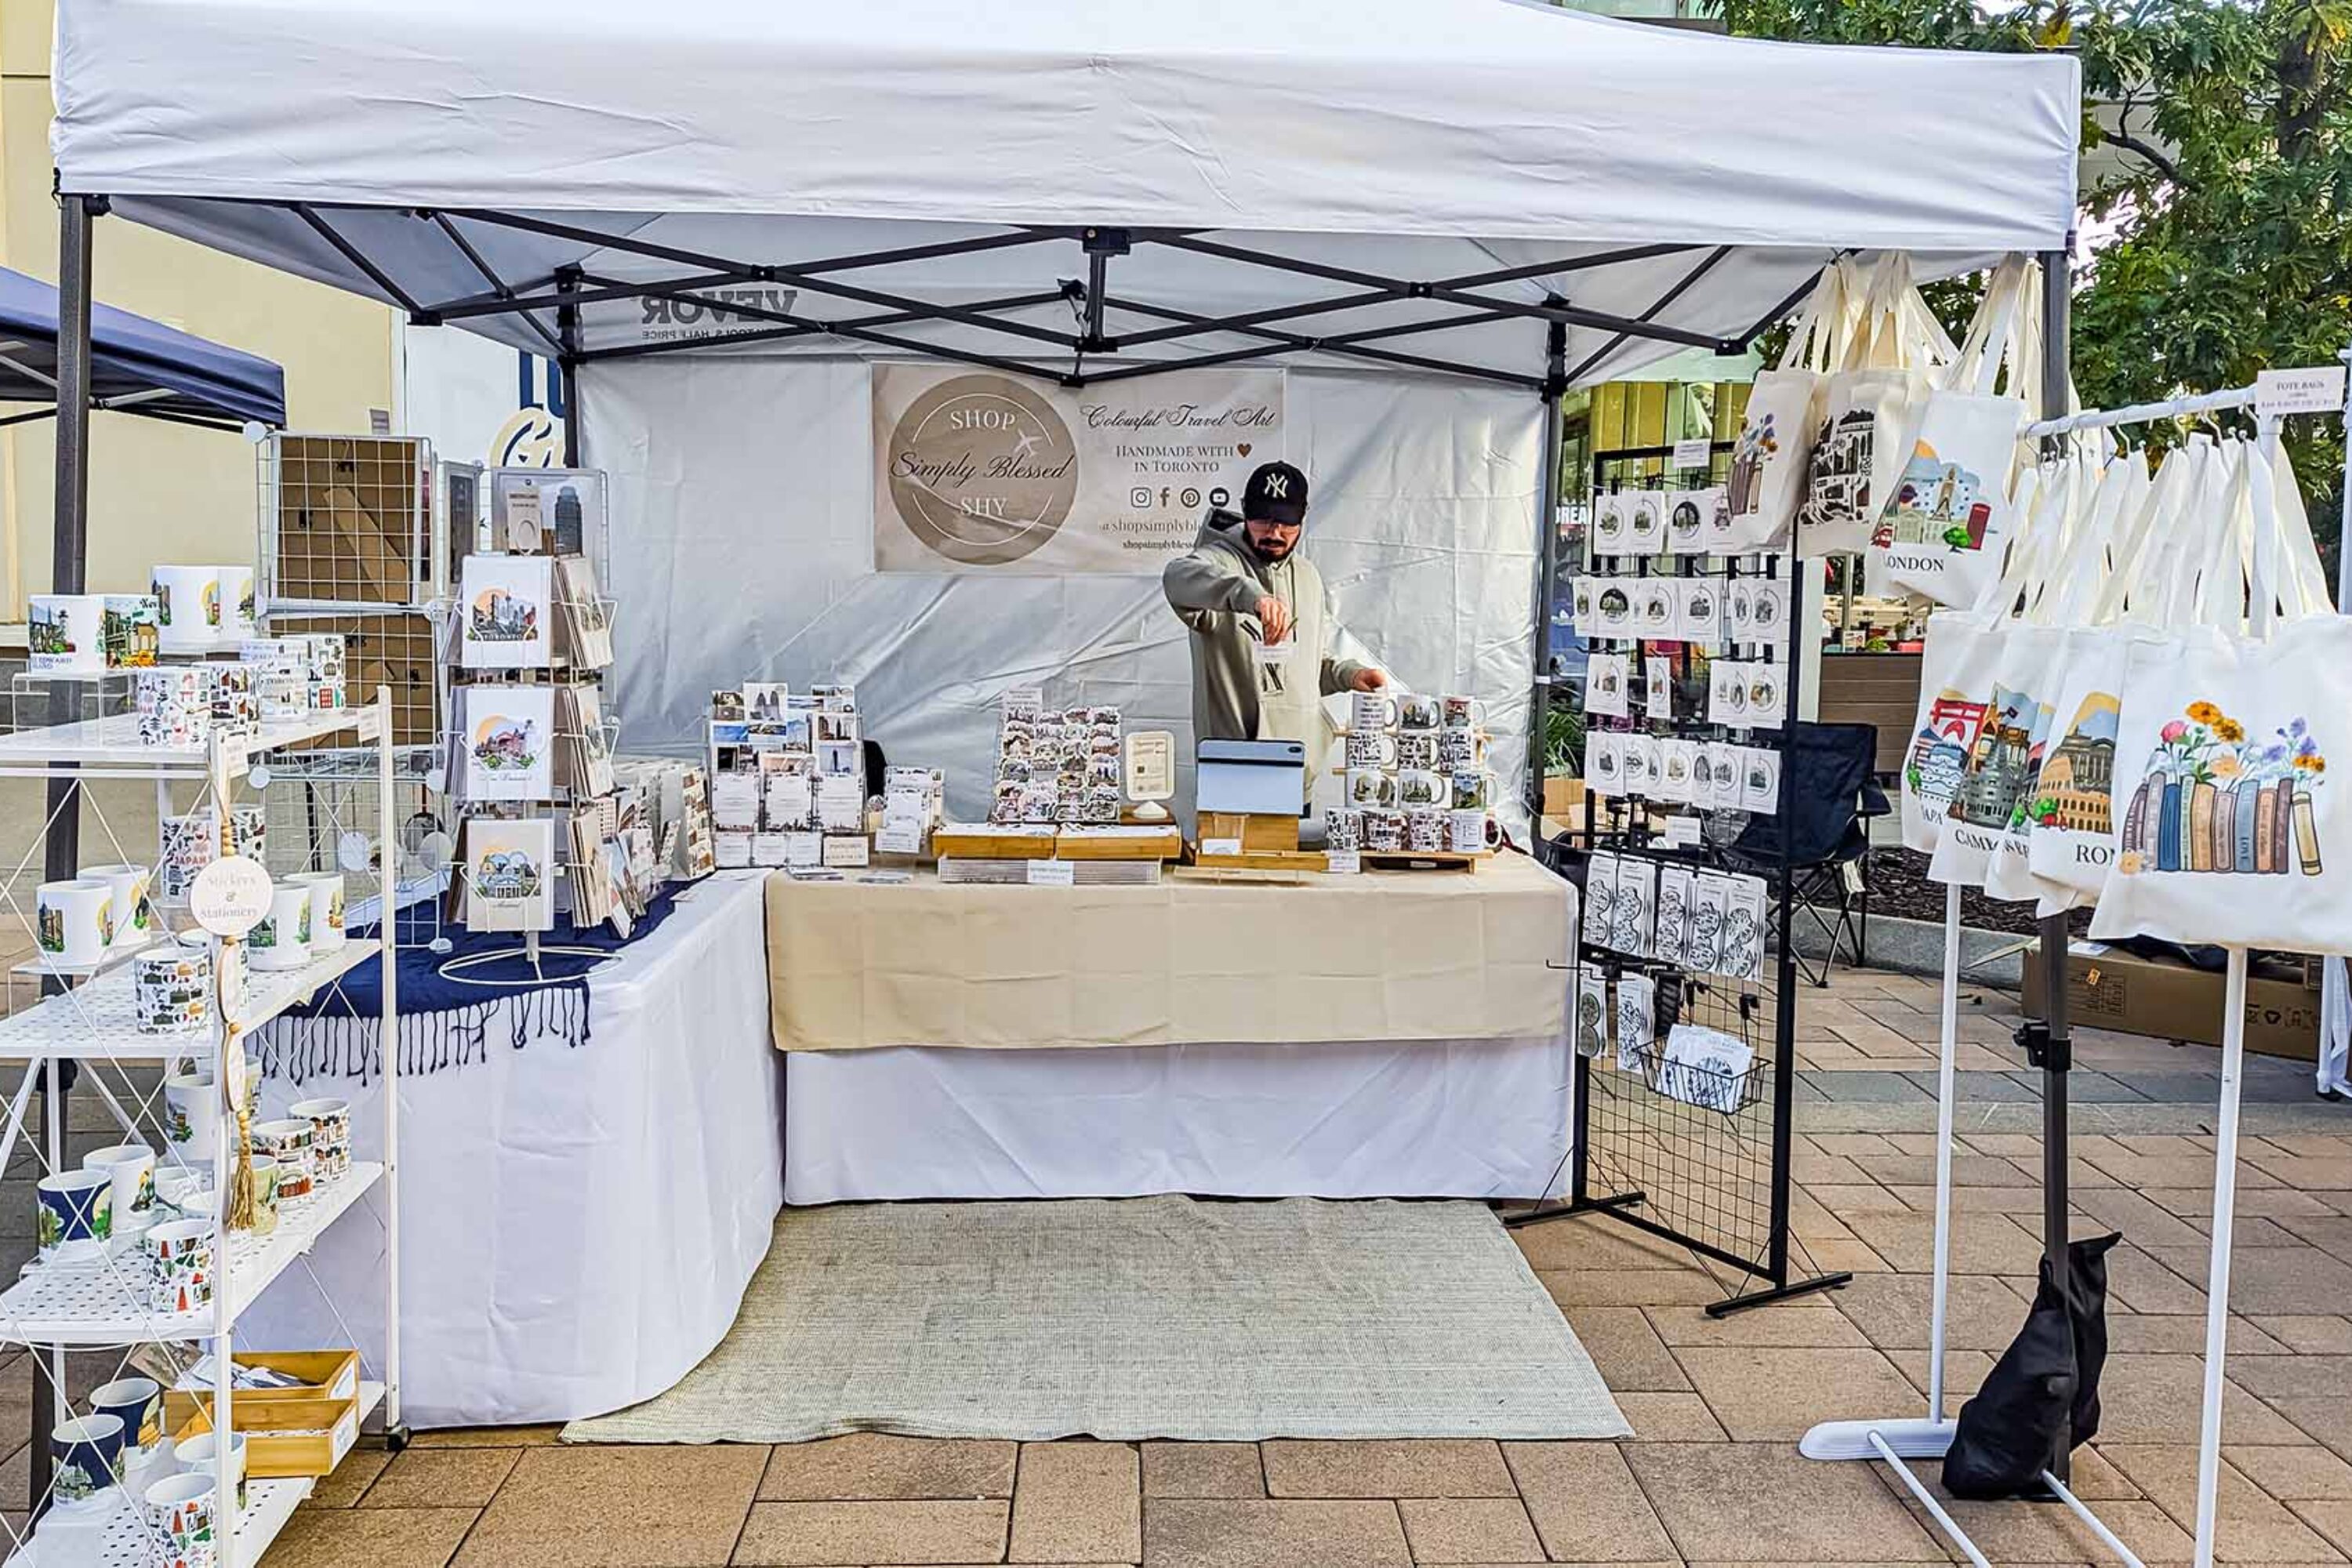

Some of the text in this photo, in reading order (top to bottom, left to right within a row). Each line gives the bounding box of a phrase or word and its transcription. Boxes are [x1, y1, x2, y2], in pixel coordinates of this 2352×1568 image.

[950, 408, 1017, 430] SHOP
[1080, 403, 1276, 431] Colourful Travel Art
[890, 451, 1075, 488] Simply Blessed
[1264, 472, 1289, 499] NY
[960, 497, 1007, 517] SHY
[174, 855, 208, 866] JAPAN
